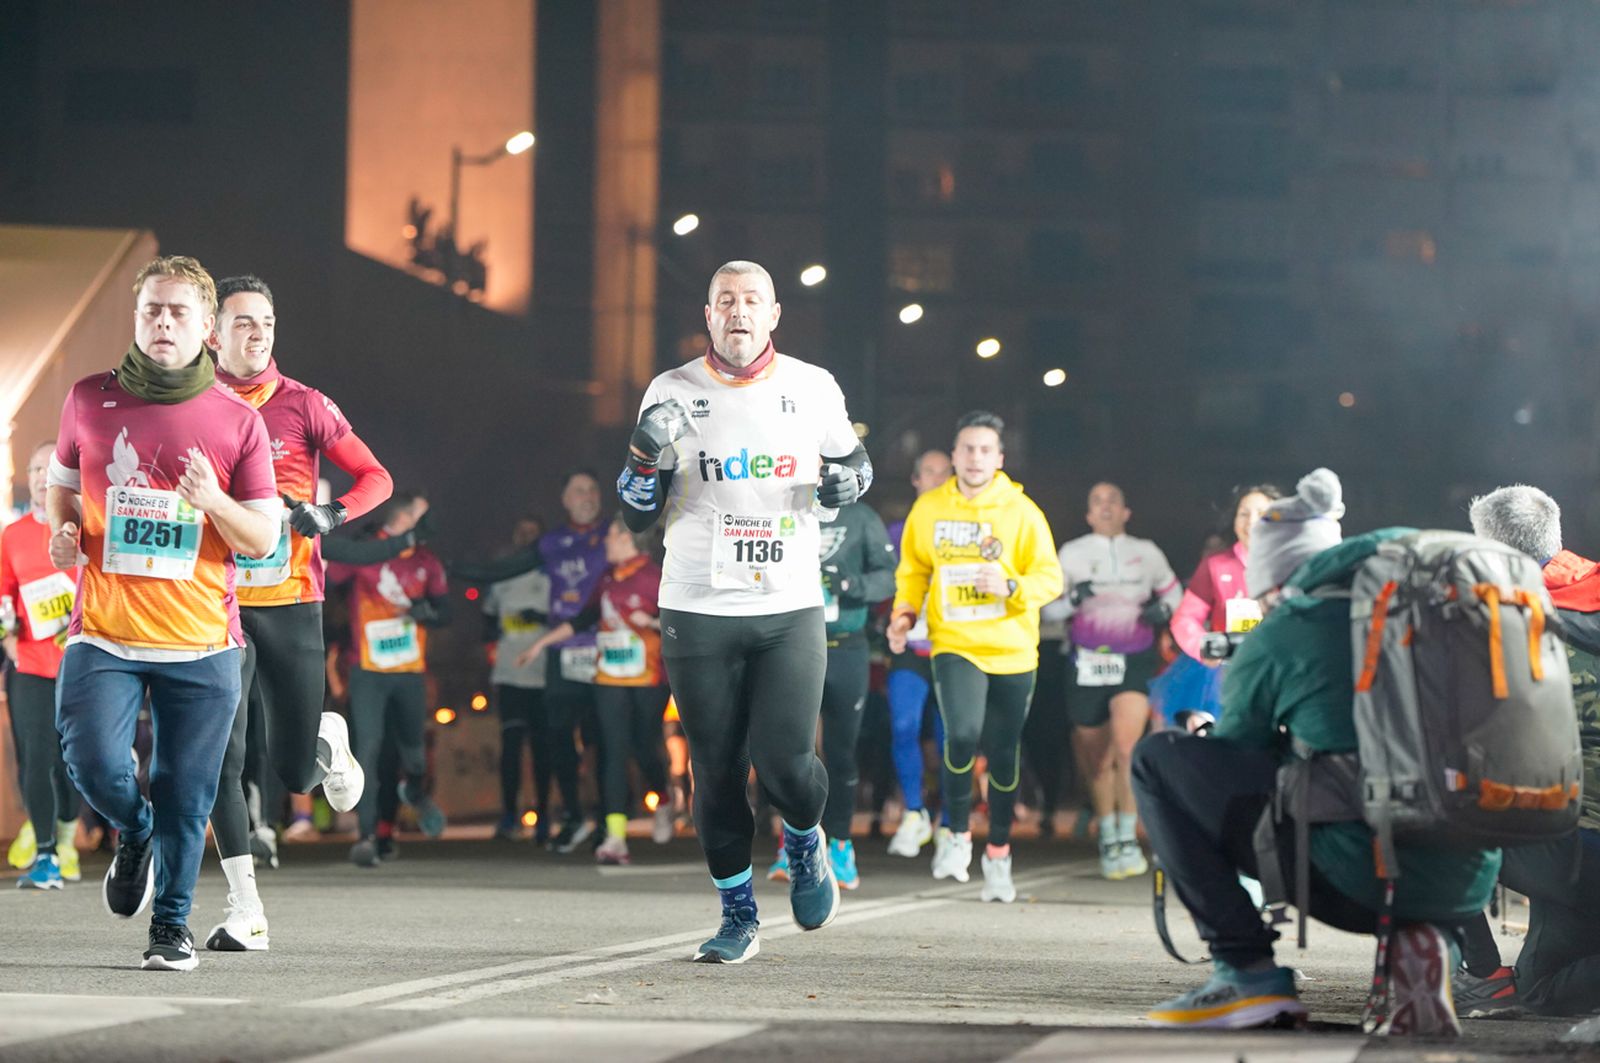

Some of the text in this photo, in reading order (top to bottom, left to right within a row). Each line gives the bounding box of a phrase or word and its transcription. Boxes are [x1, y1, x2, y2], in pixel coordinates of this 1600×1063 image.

[699, 448, 797, 481] indea
[128, 497, 156, 508] NOCHE
[158, 500, 169, 509] DE
[117, 506, 135, 516] SAN
[734, 519, 772, 528] NOCHE DE
[124, 518, 183, 549] 8251
[724, 528, 741, 537] SAN
[733, 540, 784, 563] 1136
